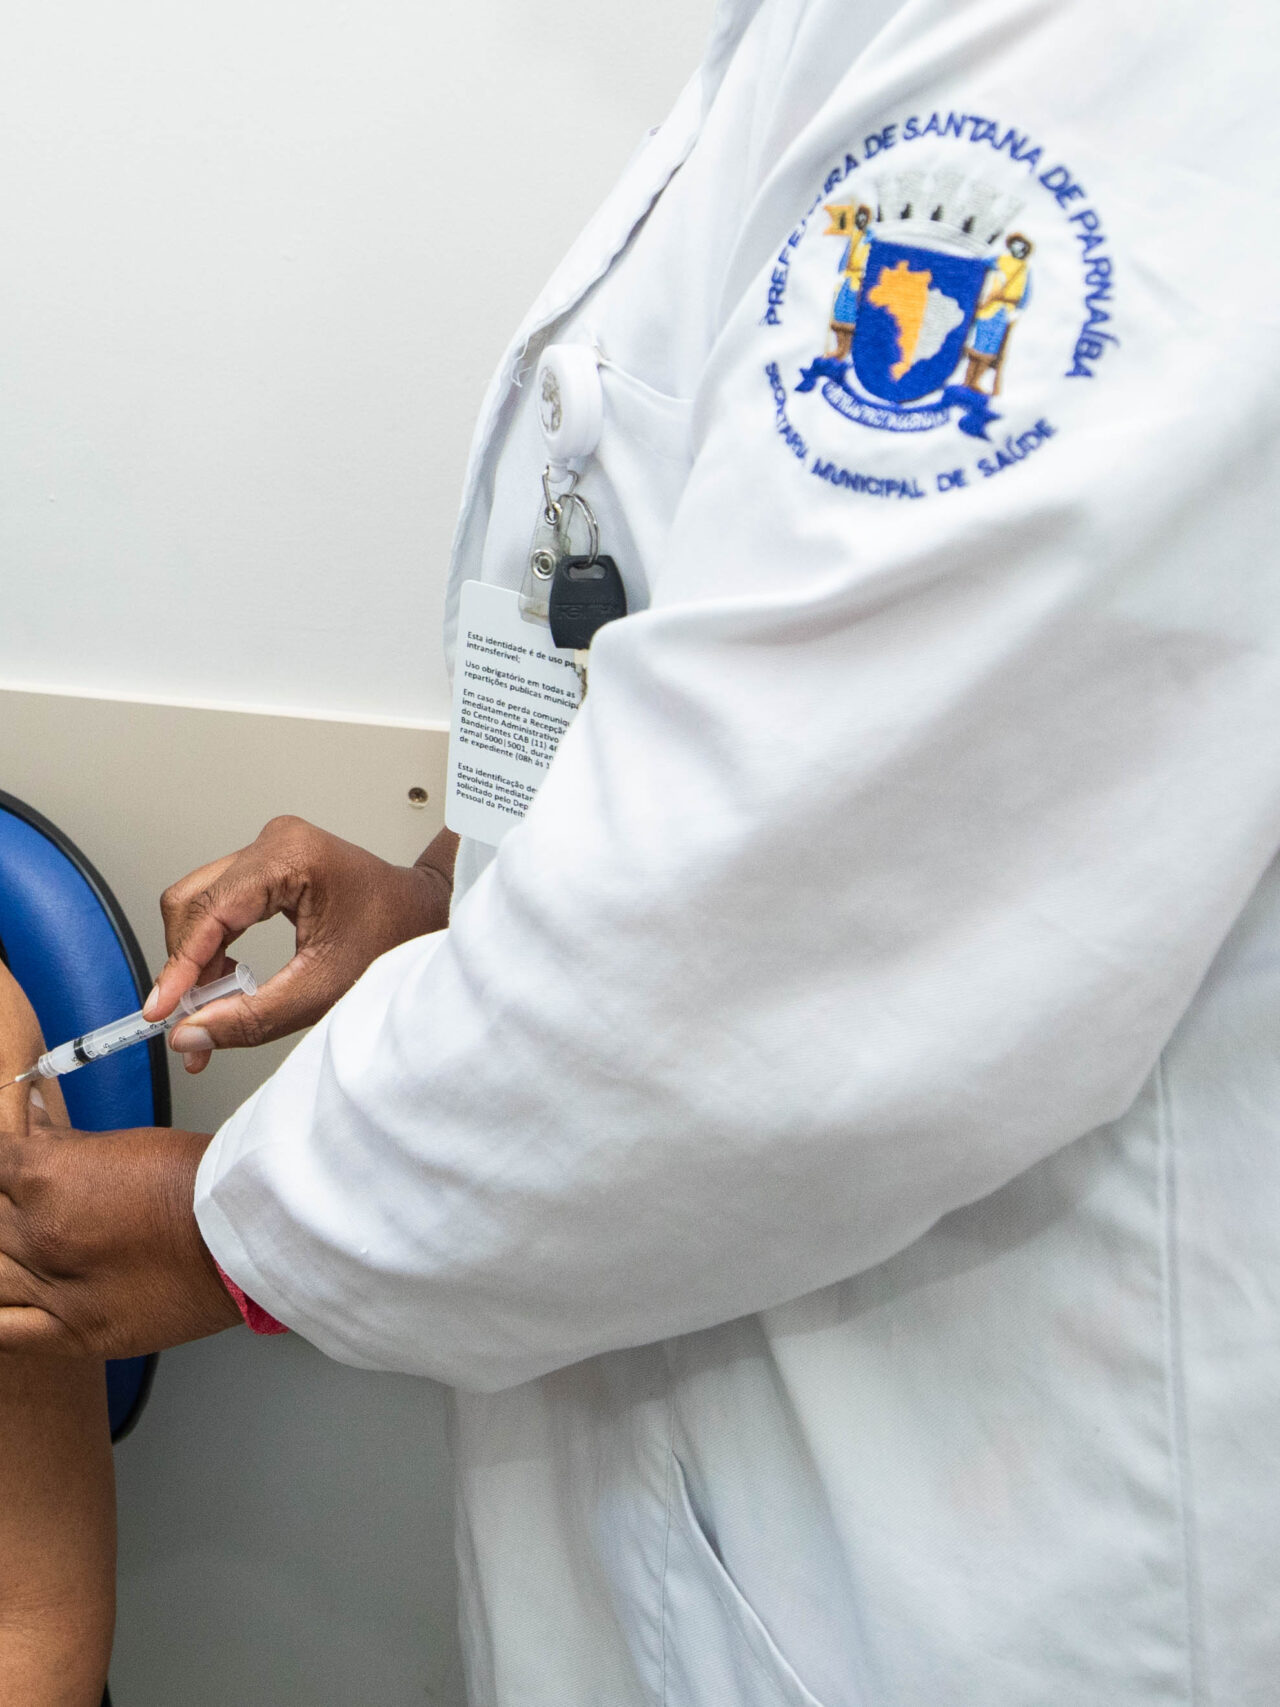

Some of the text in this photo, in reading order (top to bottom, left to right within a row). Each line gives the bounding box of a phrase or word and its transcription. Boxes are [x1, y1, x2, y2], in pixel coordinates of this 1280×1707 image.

[864, 124, 898, 160] DE
[902, 111, 1045, 174] SANTANA
[1039, 166, 1086, 210] DE
[1065, 209, 1120, 378] PARNAÍBA
[811, 458, 926, 499] MUNICIPAL
[936, 468, 968, 493] DE
[976, 419, 1058, 478] SAÚDE
[467, 631, 483, 642] Esta
[485, 635, 527, 654] identidade
[529, 648, 535, 656] é
[536, 651, 547, 660] de
[548, 655, 563, 665] uso
[464, 670, 508, 689] repartições
[465, 659, 576, 698] Uso obrigatório em todas as
[462, 698, 521, 721] imediatamente
[463, 688, 475, 698] Em
[476, 693, 495, 704] caso
[496, 698, 506, 707] de
[507, 702, 531, 715] perda
[459, 726, 483, 739] ramal
[460, 716, 512, 738] Bandeirantes
[512, 732, 530, 744] CAB
[531, 738, 547, 751] (11)
[461, 707, 560, 744] do Centro Administrativo
[459, 735, 469, 744] de
[470, 739, 514, 758] expediente
[457, 762, 538, 793] Esta identificação de
[457, 771, 494, 789] devolvida
[456, 781, 493, 798] solicitado
[494, 792, 512, 805] pelo
[456, 789, 485, 805] Pessoal
[485, 799, 496, 809] da
